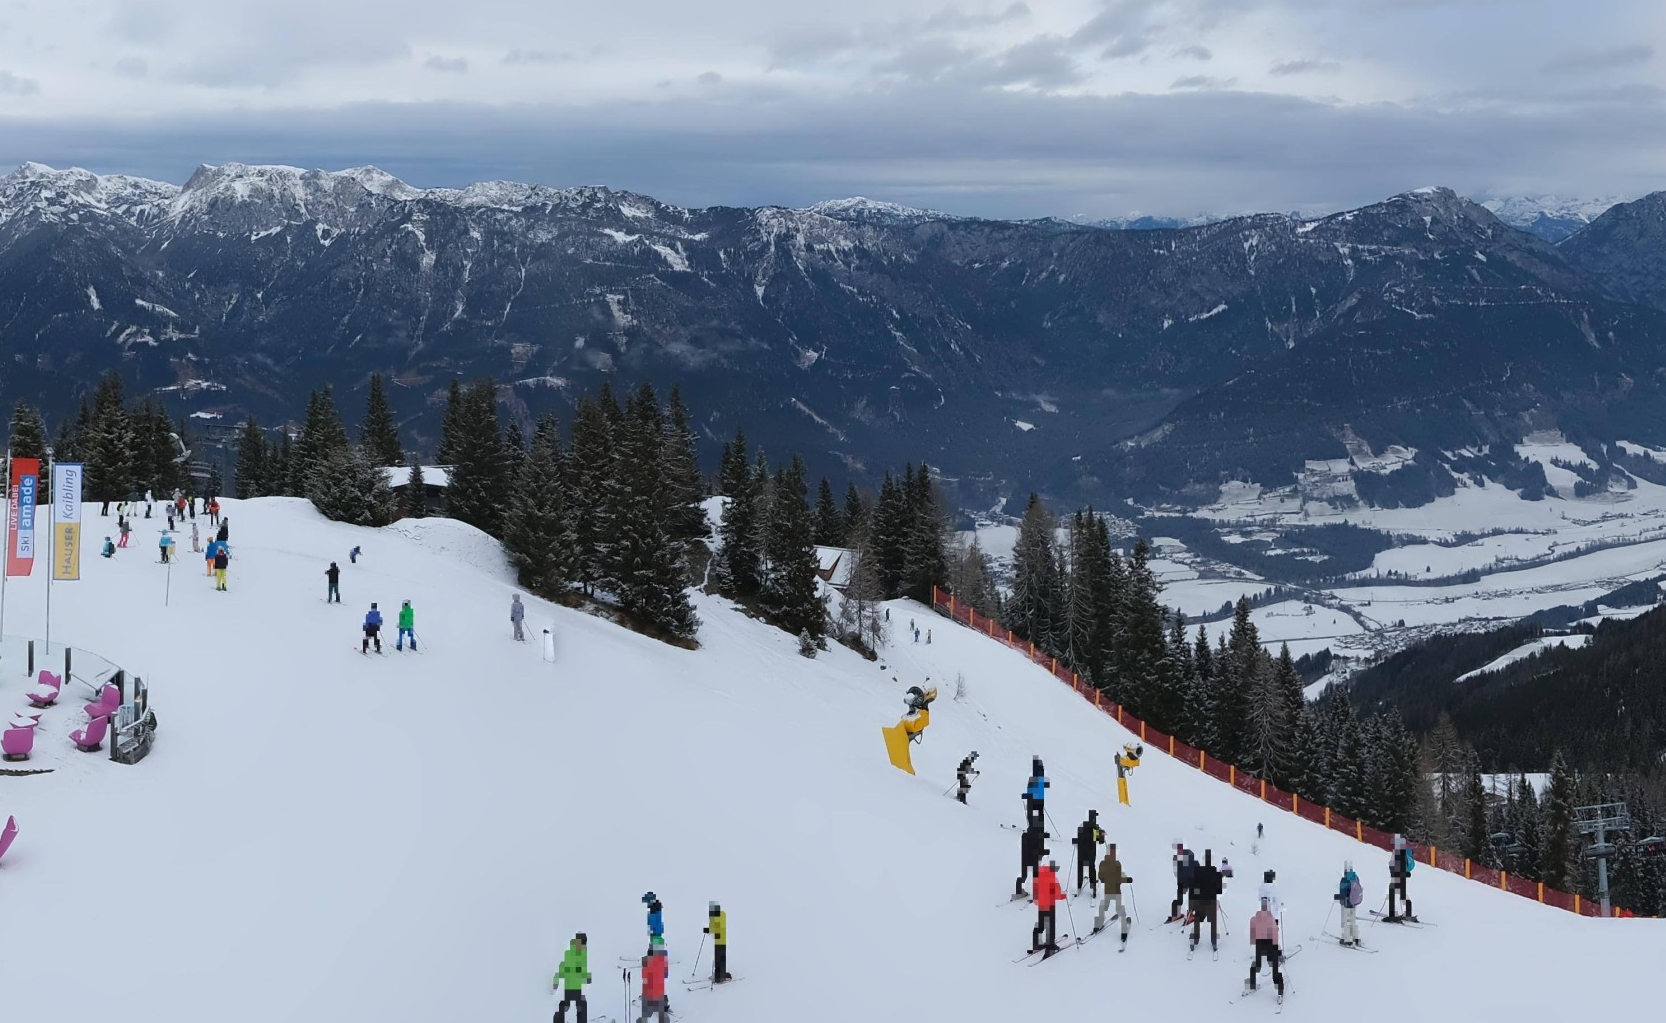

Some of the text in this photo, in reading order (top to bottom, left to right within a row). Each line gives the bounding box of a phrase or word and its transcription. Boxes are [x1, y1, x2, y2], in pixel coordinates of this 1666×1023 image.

[10, 484, 19, 531] LIVE DABEI
[62, 469, 77, 520] Kaibling
[20, 536, 30, 552] Ski
